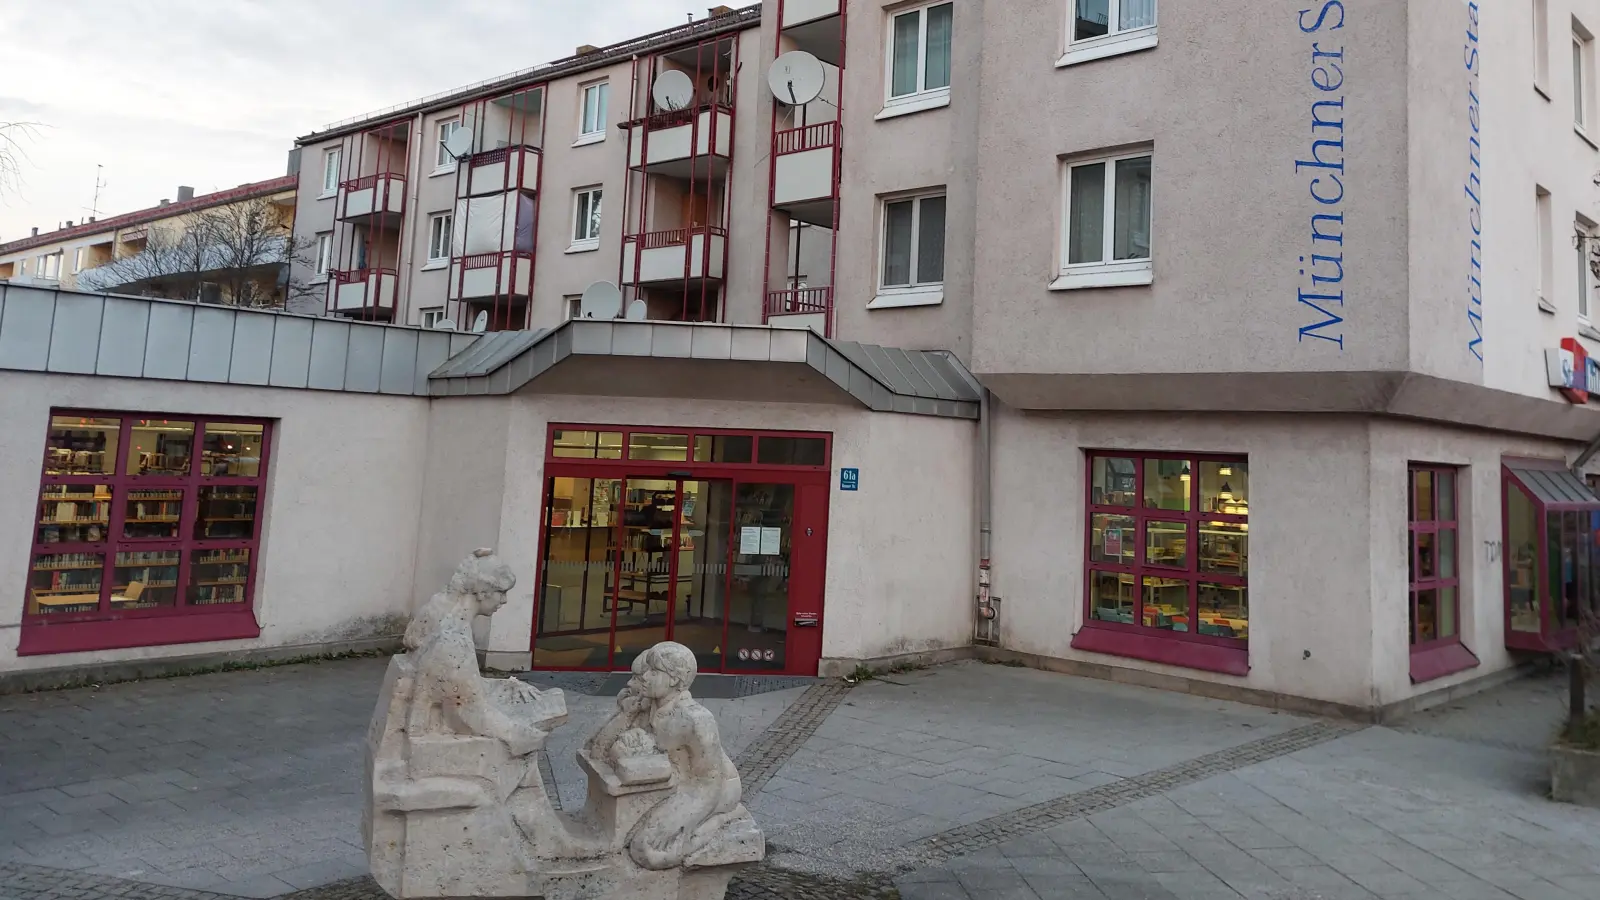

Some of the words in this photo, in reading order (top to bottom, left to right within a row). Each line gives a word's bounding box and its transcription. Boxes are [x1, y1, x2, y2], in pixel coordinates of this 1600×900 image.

[1295, 42, 1344, 350] Münchner
[1464, 81, 1484, 363] Münchner
[843, 469, 856, 480] 61a
